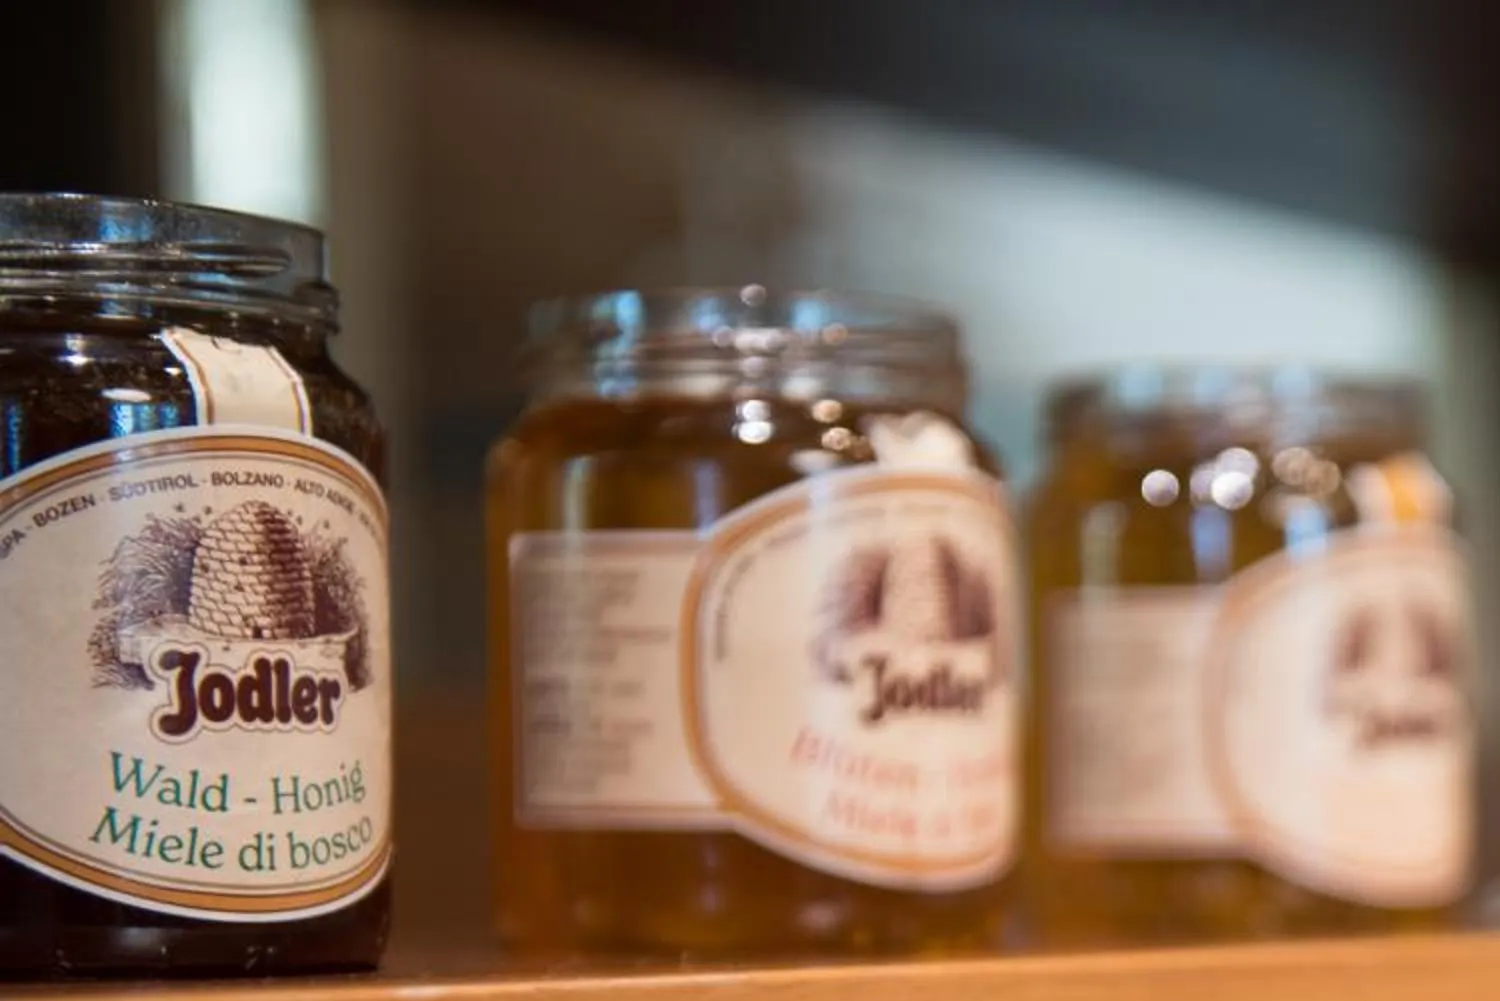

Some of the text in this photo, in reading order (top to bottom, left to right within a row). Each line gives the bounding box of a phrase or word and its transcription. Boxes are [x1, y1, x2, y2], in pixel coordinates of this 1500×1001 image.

[32, 493, 96, 528] BOZEN
[211, 471, 284, 487] BOLZANO
[158, 650, 341, 736] Jodler
[110, 751, 229, 812] Wald
[272, 760, 367, 815] Honig
[89, 806, 373, 871] Miele di bosco
